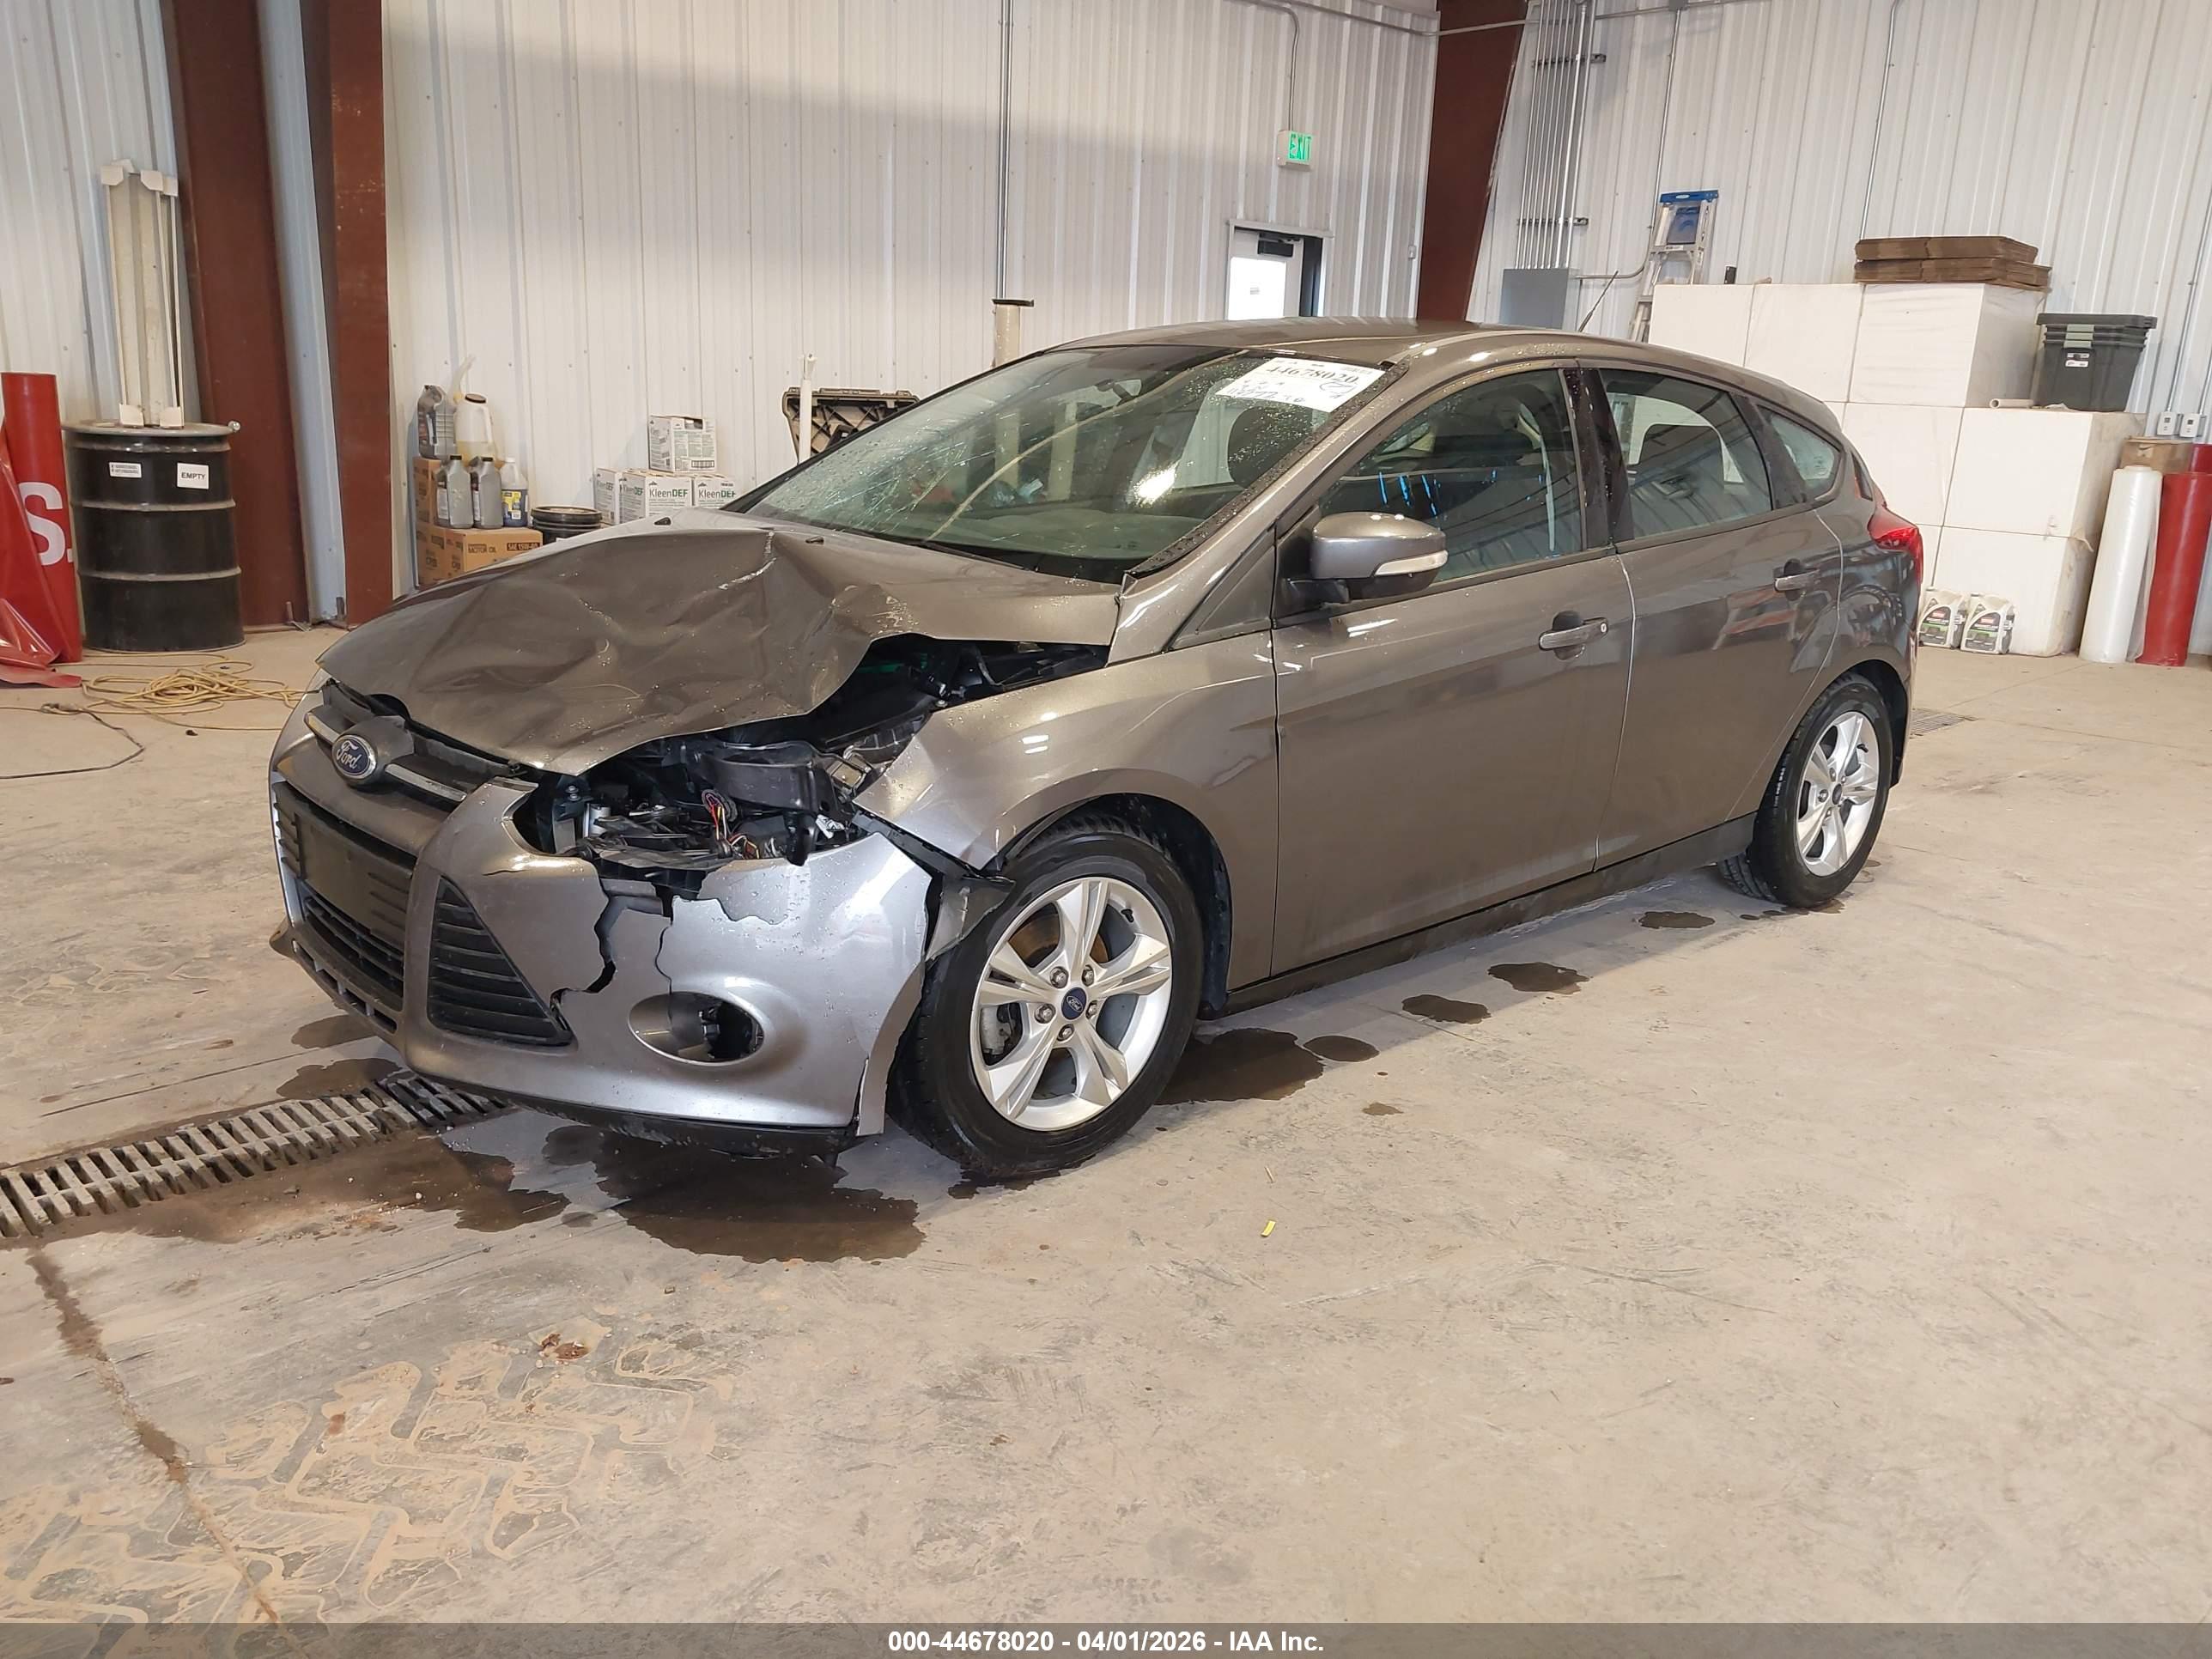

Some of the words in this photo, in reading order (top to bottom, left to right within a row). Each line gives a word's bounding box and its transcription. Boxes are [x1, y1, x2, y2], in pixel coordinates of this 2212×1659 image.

[1289, 133, 1311, 161] EXIT
[180, 471, 206, 480] EMPTY
[649, 488, 688, 499] KleenDEF
[698, 489, 736, 499] KleenDEF
[336, 740, 360, 769] Ford
